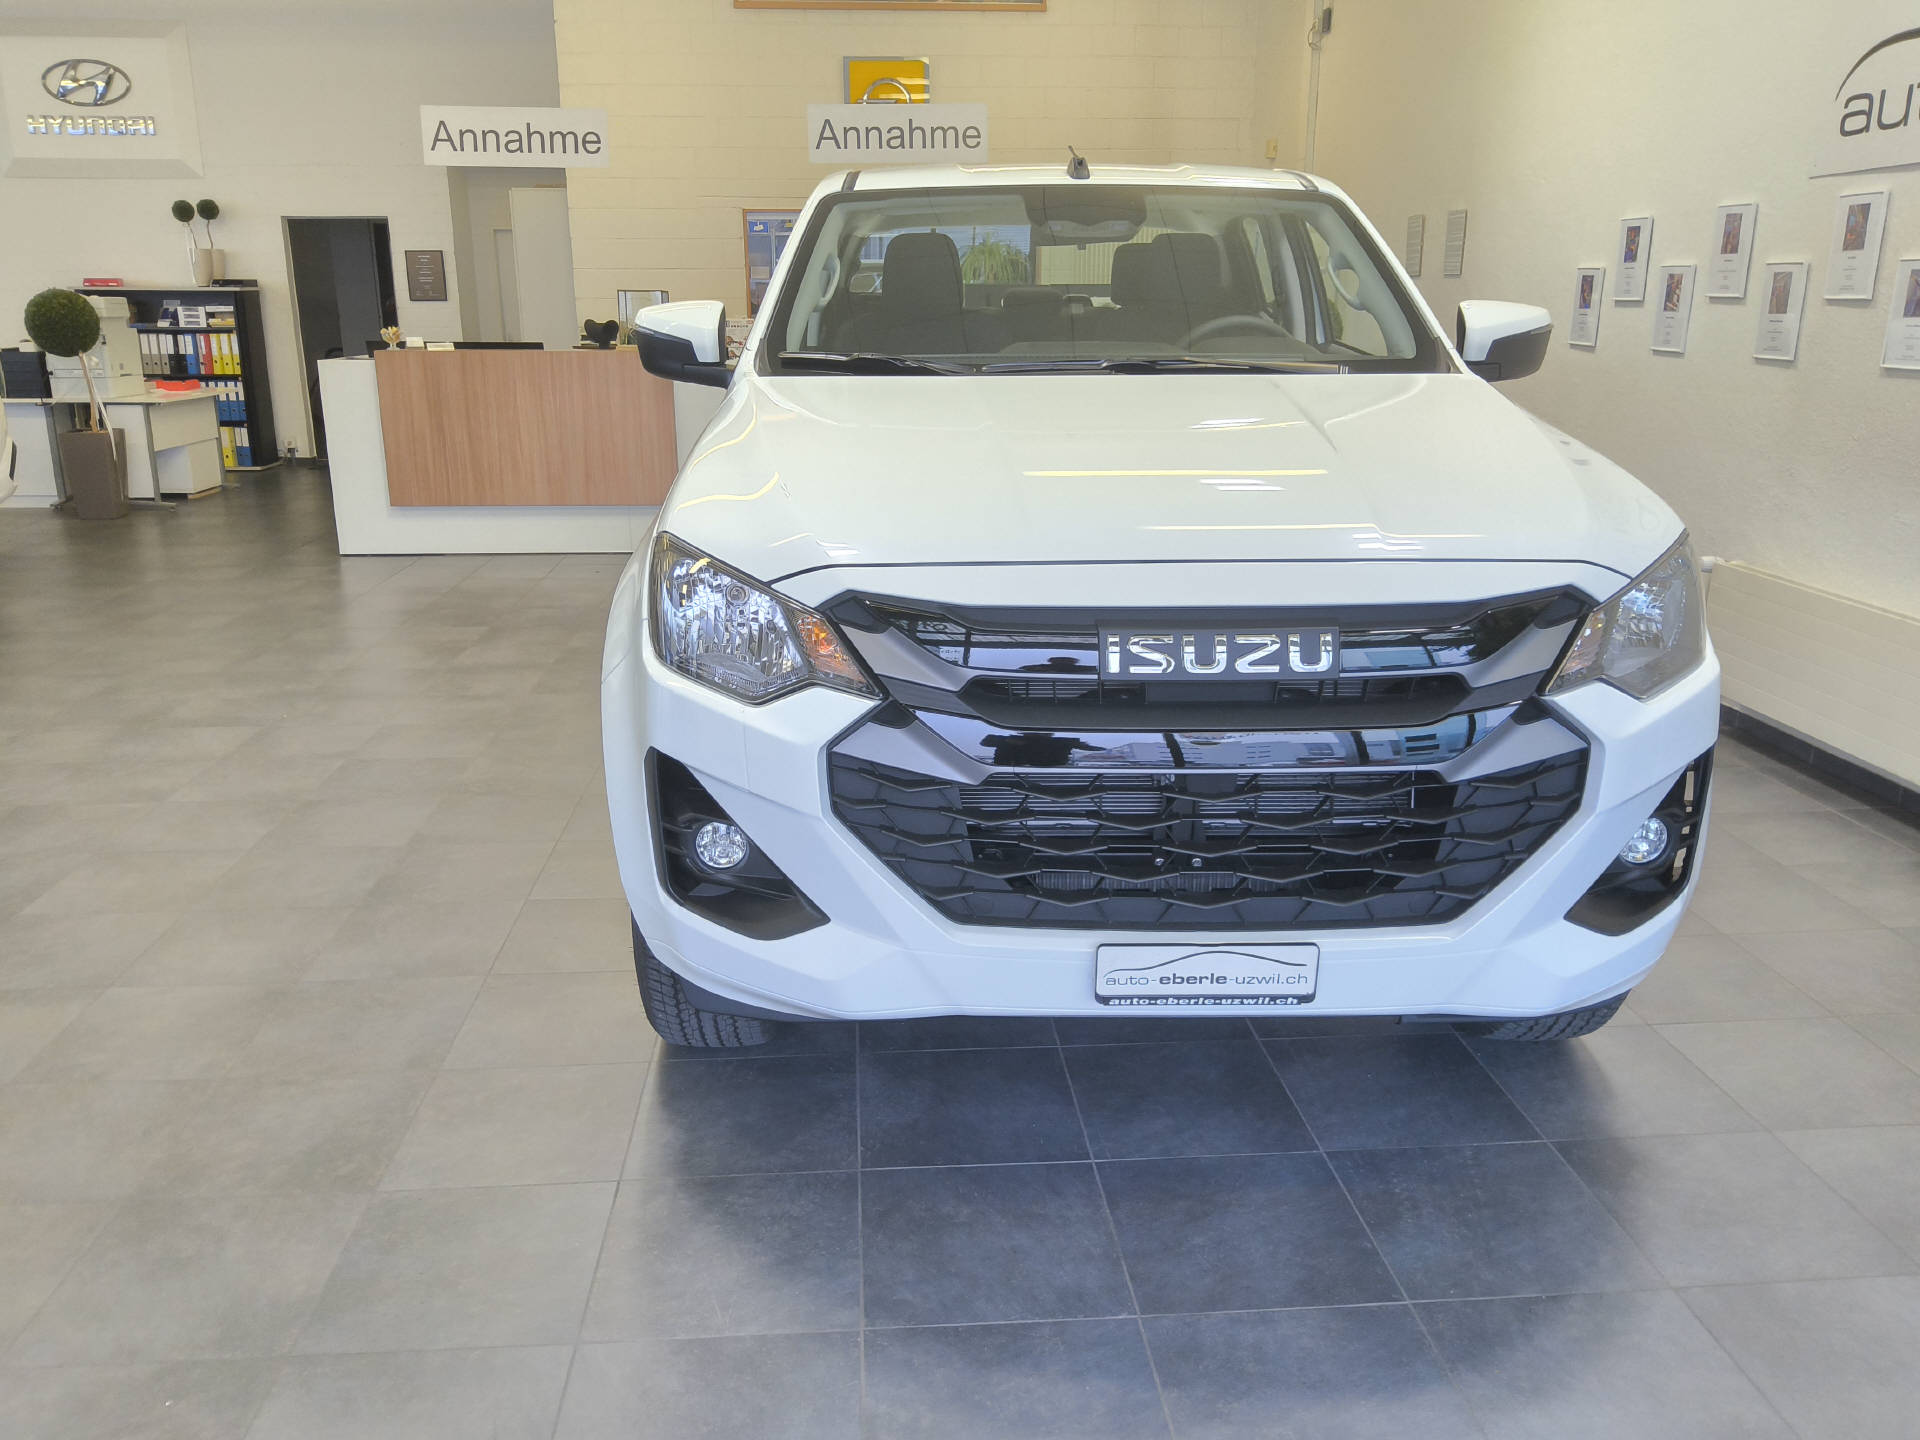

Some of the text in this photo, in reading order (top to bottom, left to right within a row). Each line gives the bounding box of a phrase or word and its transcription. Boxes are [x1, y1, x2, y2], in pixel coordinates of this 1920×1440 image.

[26, 115, 156, 136] HYUNDAI
[1840, 82, 1920, 137] au
[430, 120, 602, 154] Annahme
[815, 118, 982, 150] Annahme
[1106, 633, 1334, 674] ISUZU
[1104, 972, 1308, 986] auto-eberle-uzwil.ch
[1108, 997, 1299, 1005] auto-eberle-uzwil.ch
